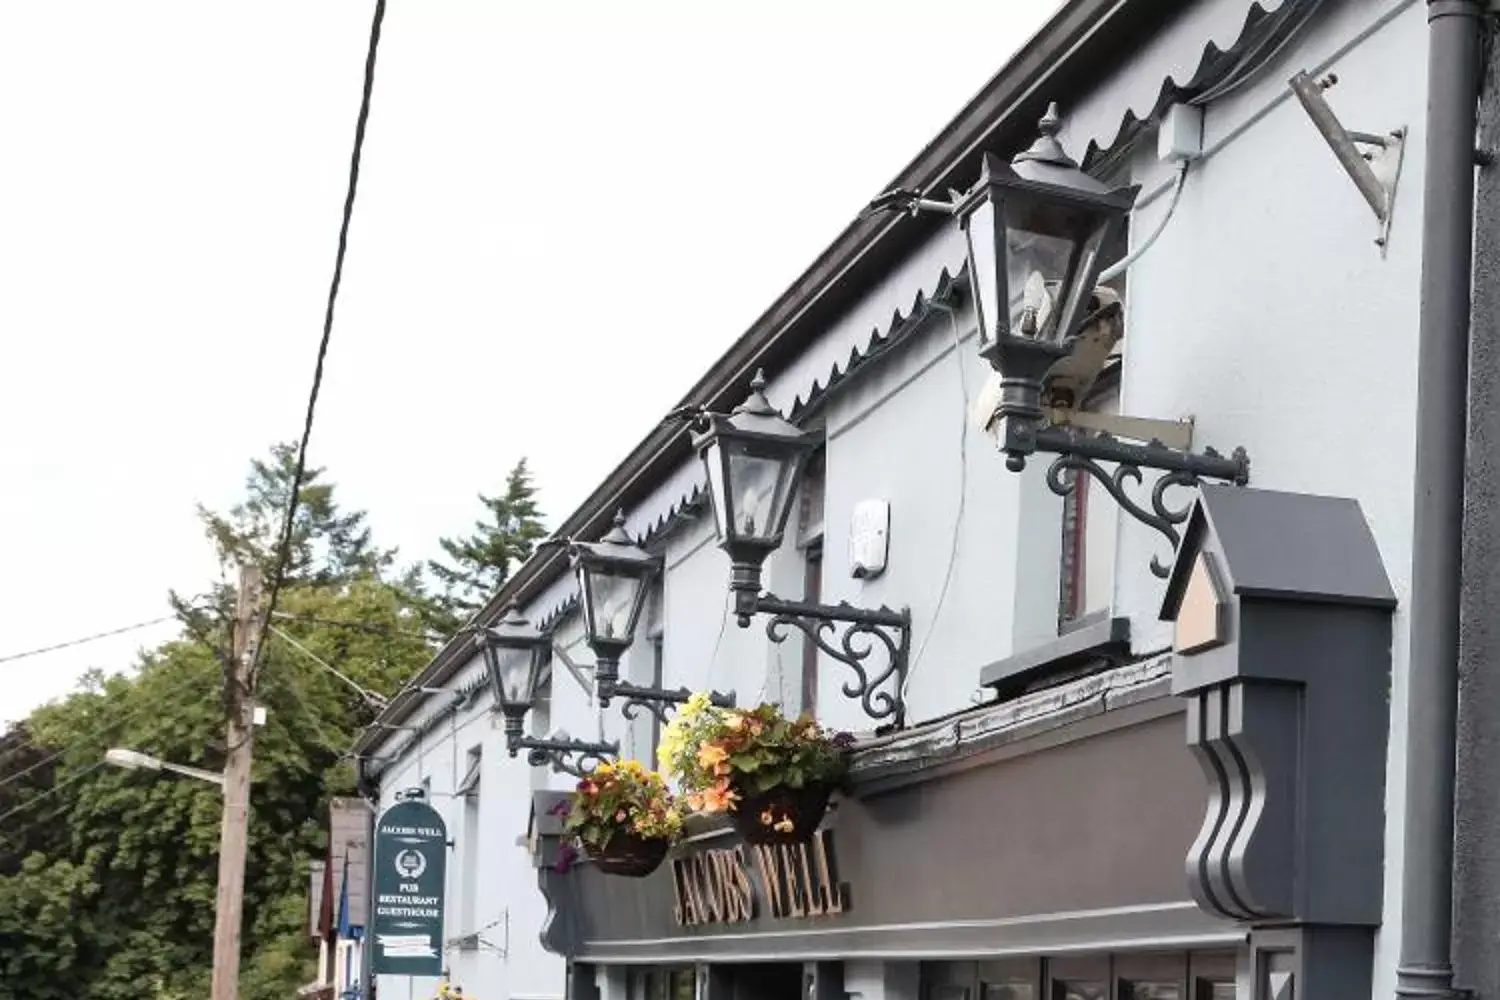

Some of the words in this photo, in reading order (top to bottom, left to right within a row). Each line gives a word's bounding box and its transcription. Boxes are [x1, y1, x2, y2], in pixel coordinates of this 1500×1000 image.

[753, 829, 843, 919] WELL
[399, 883, 419, 893] PUB
[379, 894, 440, 905] RESTAURANT
[377, 906, 439, 917] GUESTHOUSE
